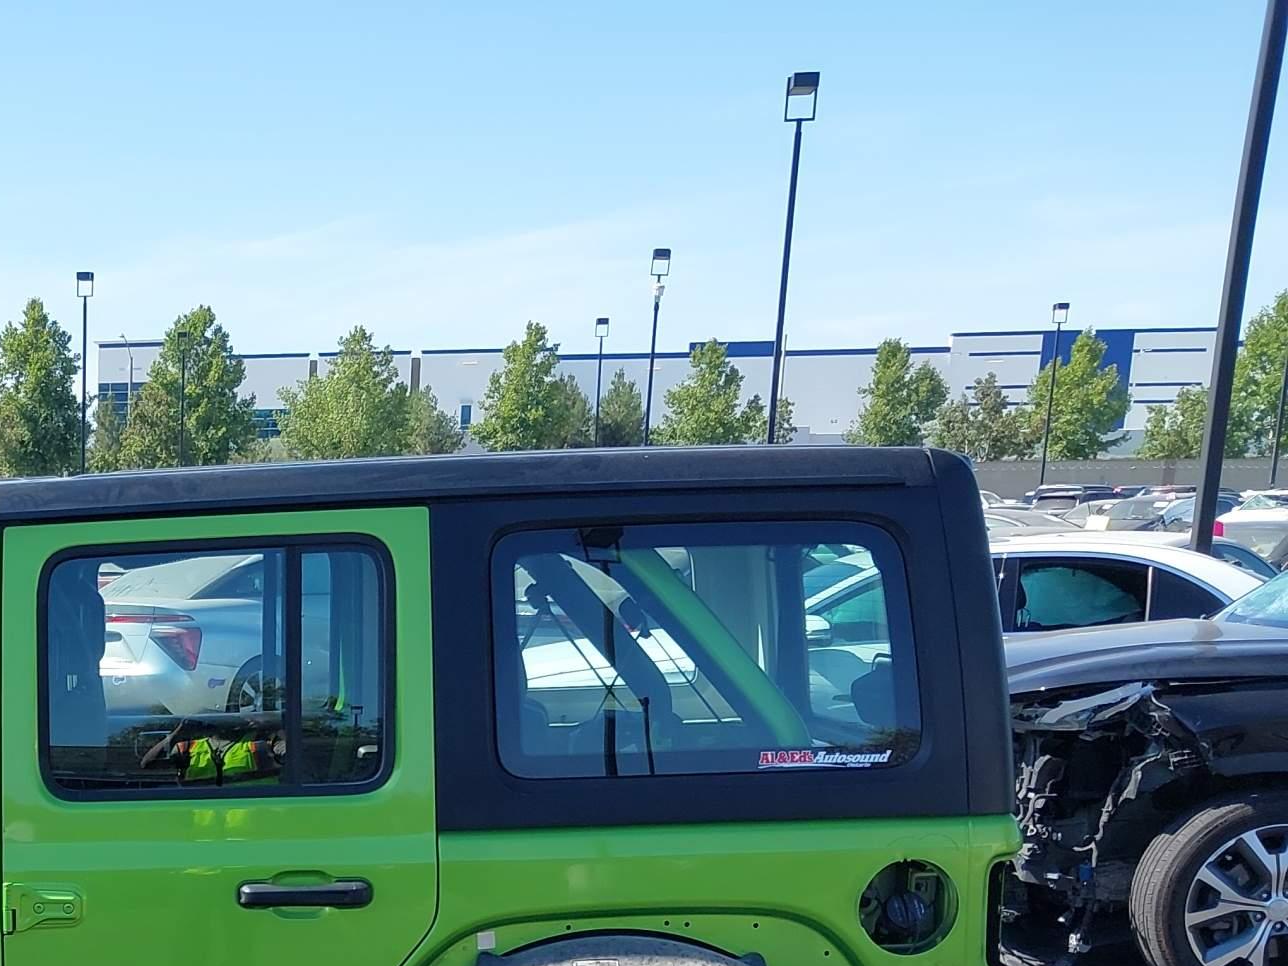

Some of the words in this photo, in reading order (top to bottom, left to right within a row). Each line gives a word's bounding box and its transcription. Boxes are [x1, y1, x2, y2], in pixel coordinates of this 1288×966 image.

[759, 751, 775, 764] Al
[777, 751, 789, 764] &
[814, 750, 892, 763] Autosound
